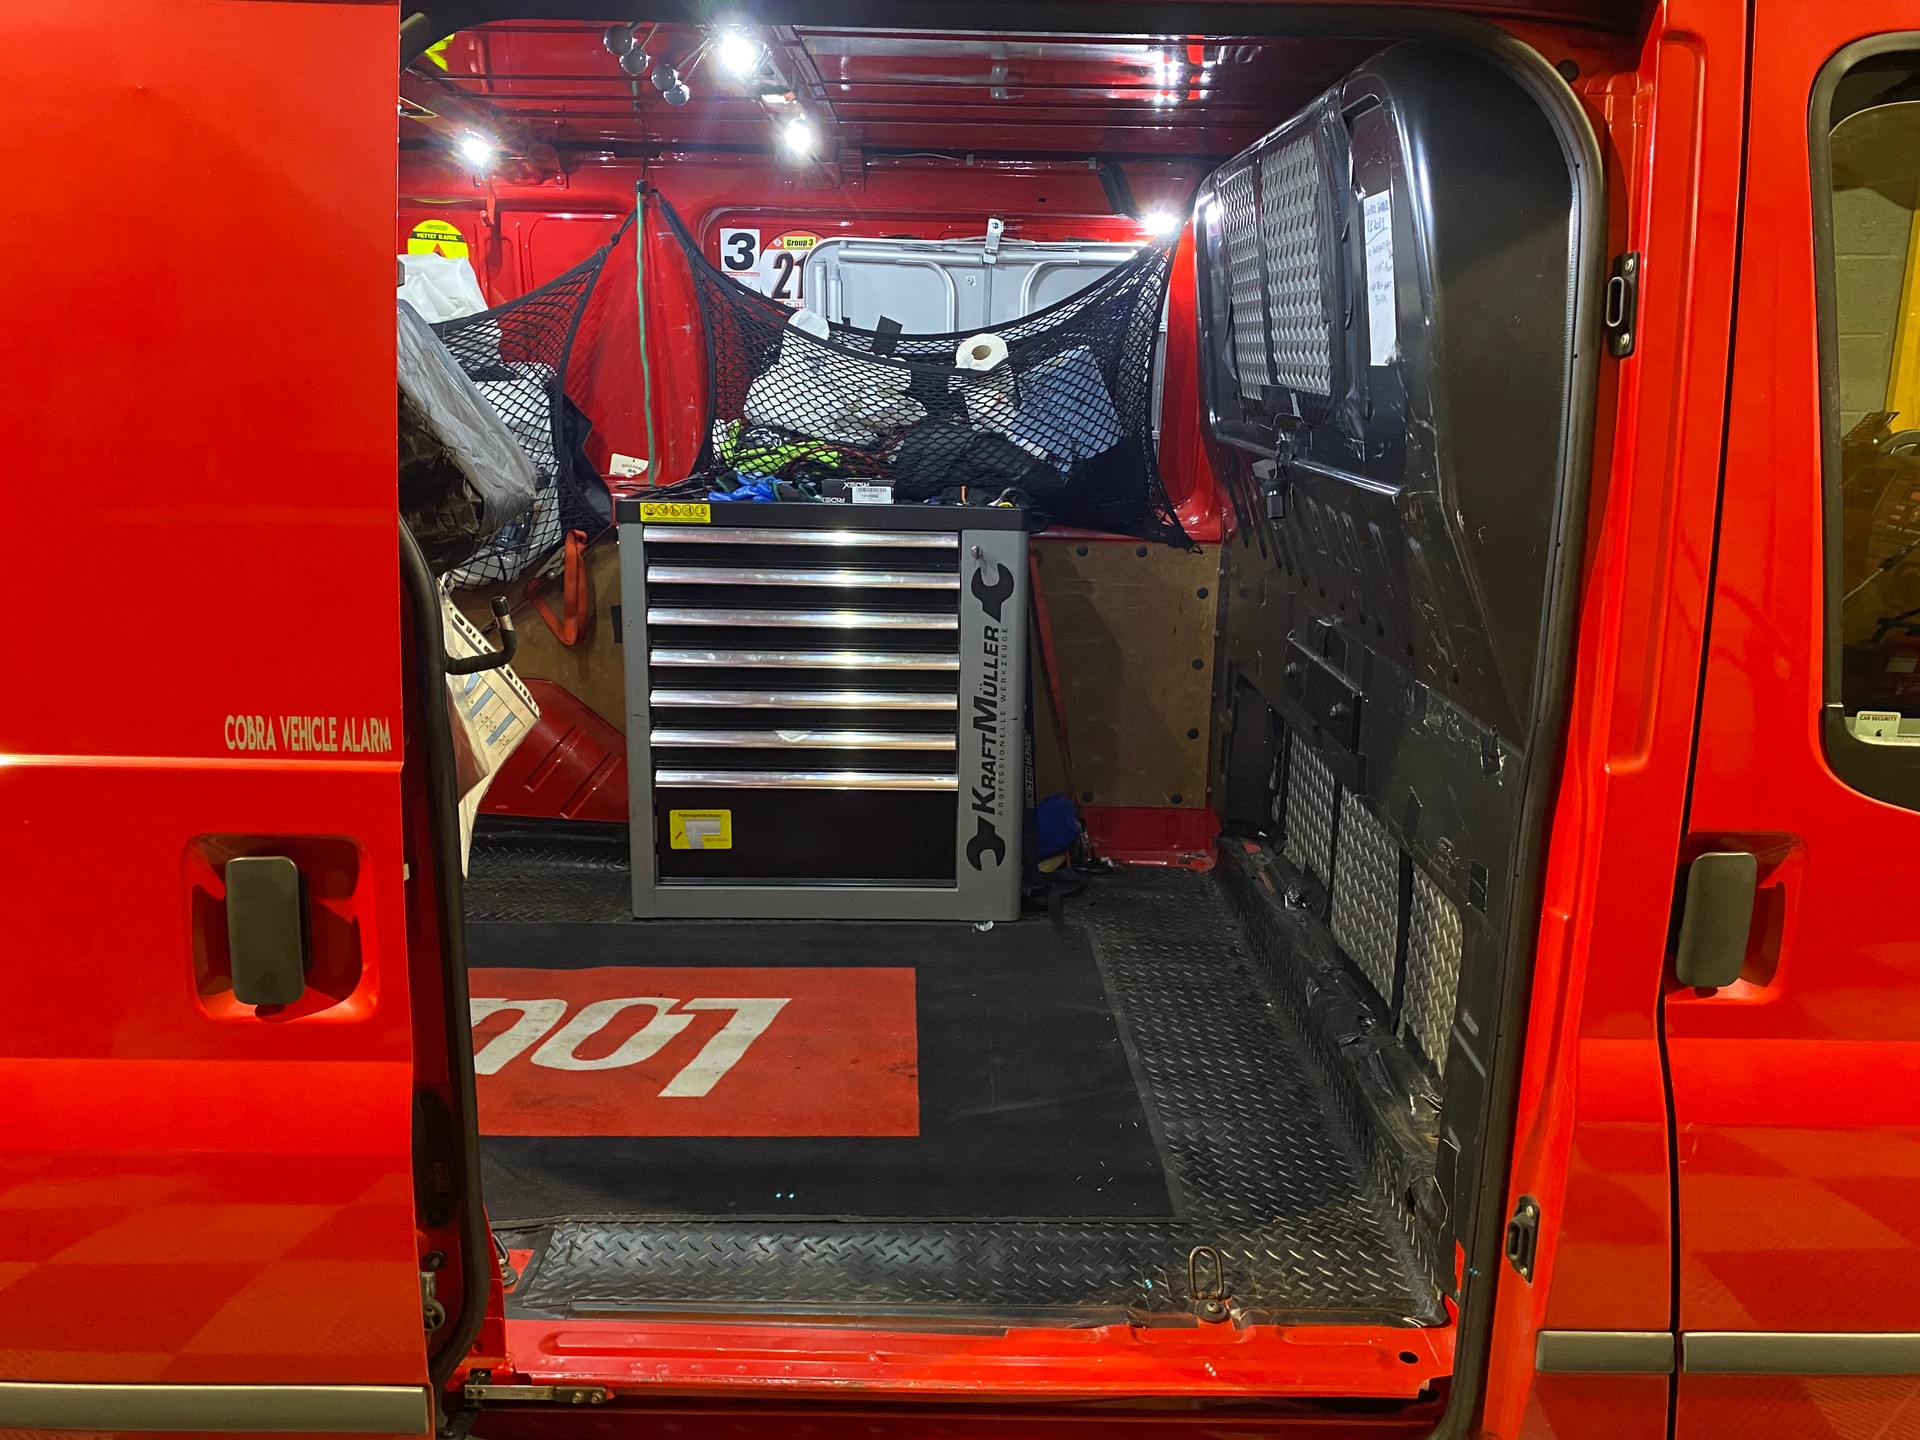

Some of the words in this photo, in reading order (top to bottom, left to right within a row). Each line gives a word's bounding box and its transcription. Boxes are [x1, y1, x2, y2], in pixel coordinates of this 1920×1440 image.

[724, 232, 756, 271] 3
[786, 238, 807, 247] Group
[808, 238, 814, 247] 3
[999, 627, 1009, 702] WERKZEUGE
[224, 714, 276, 751] COBRA
[279, 715, 338, 752] VEHICLE
[342, 716, 392, 752] ALARM
[971, 624, 999, 815] KRAFTMÜLLER
[997, 710, 1007, 816] PROFESSIONELLE
